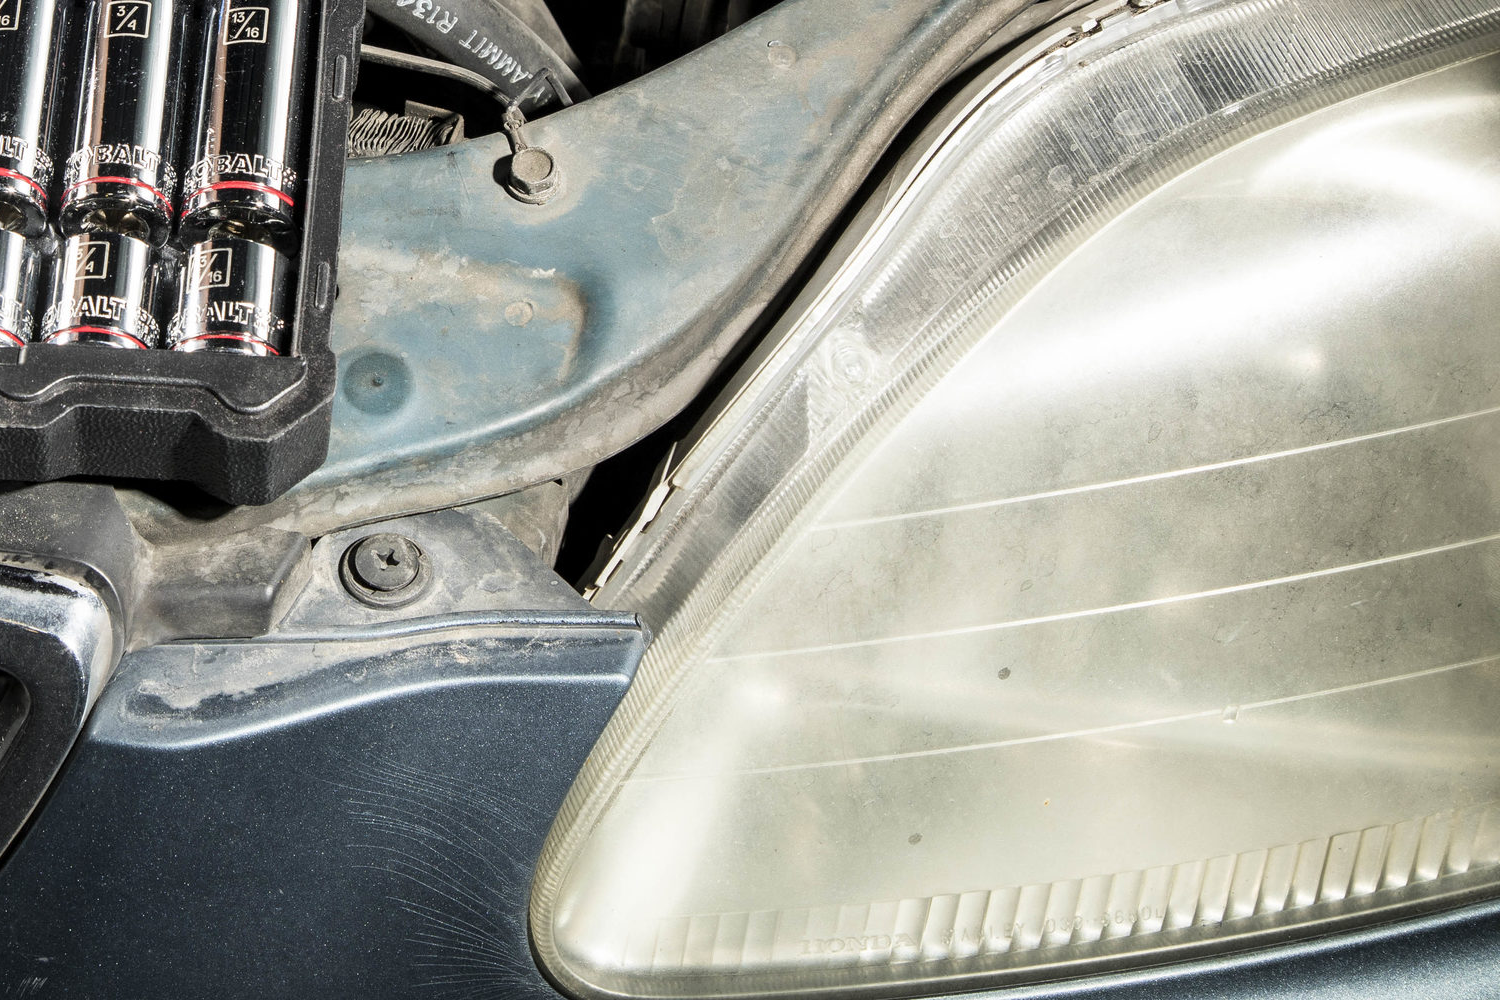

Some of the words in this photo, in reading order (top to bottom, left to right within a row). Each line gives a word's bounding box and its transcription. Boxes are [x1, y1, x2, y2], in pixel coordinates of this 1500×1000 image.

[116, 5, 139, 32] 3/4
[231, 11, 260, 40] 13/16
[799, 931, 920, 955] HONDA
